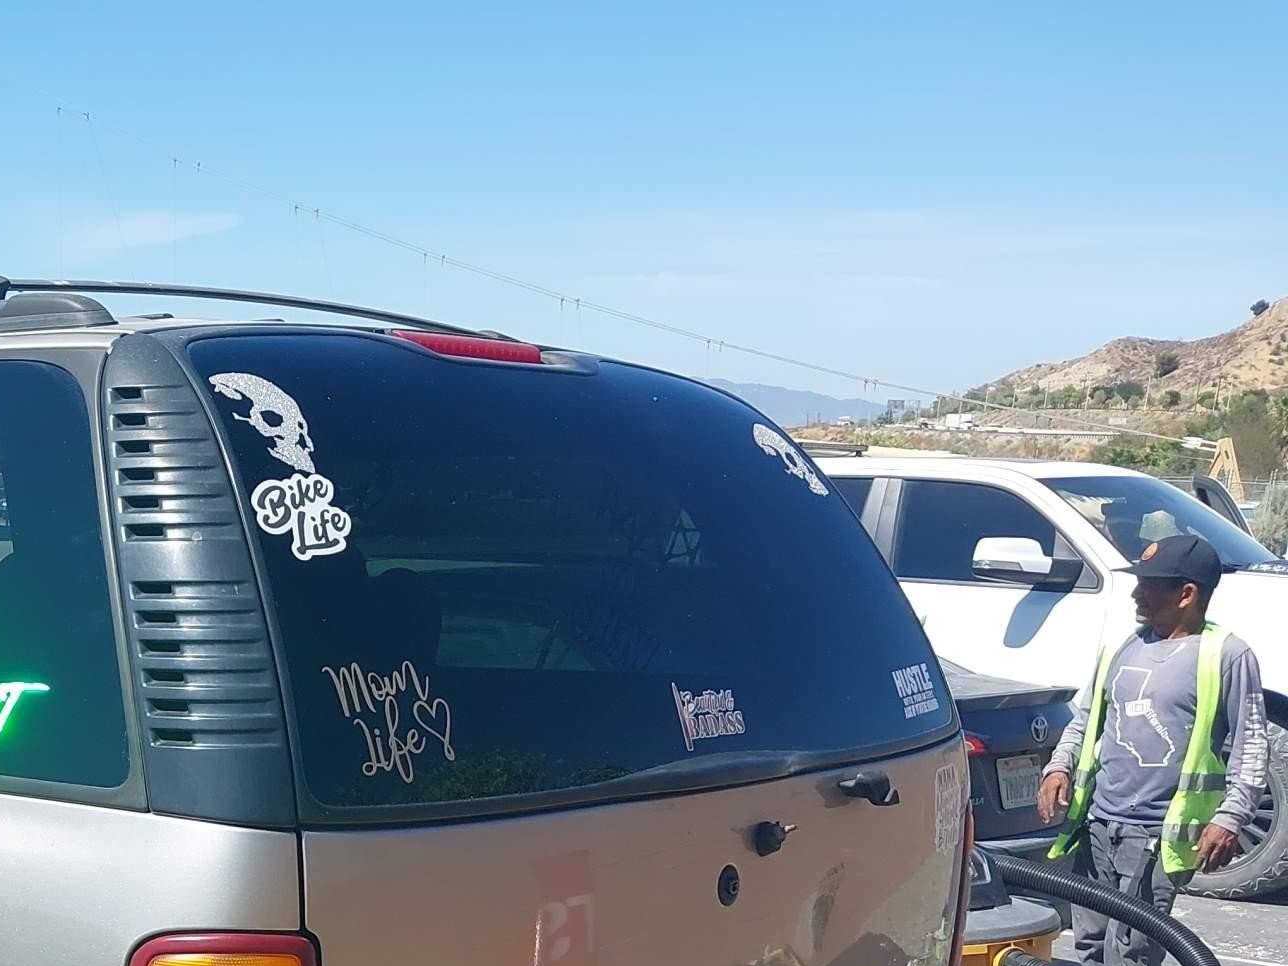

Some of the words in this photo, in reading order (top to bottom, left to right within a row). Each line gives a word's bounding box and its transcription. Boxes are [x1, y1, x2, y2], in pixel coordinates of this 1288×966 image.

[256, 478, 329, 530] Bike
[296, 508, 347, 556] Life
[321, 660, 429, 718] Mom
[891, 663, 933, 698] HUSTLE
[354, 696, 426, 784] Life
[686, 710, 746, 740] BADASS
